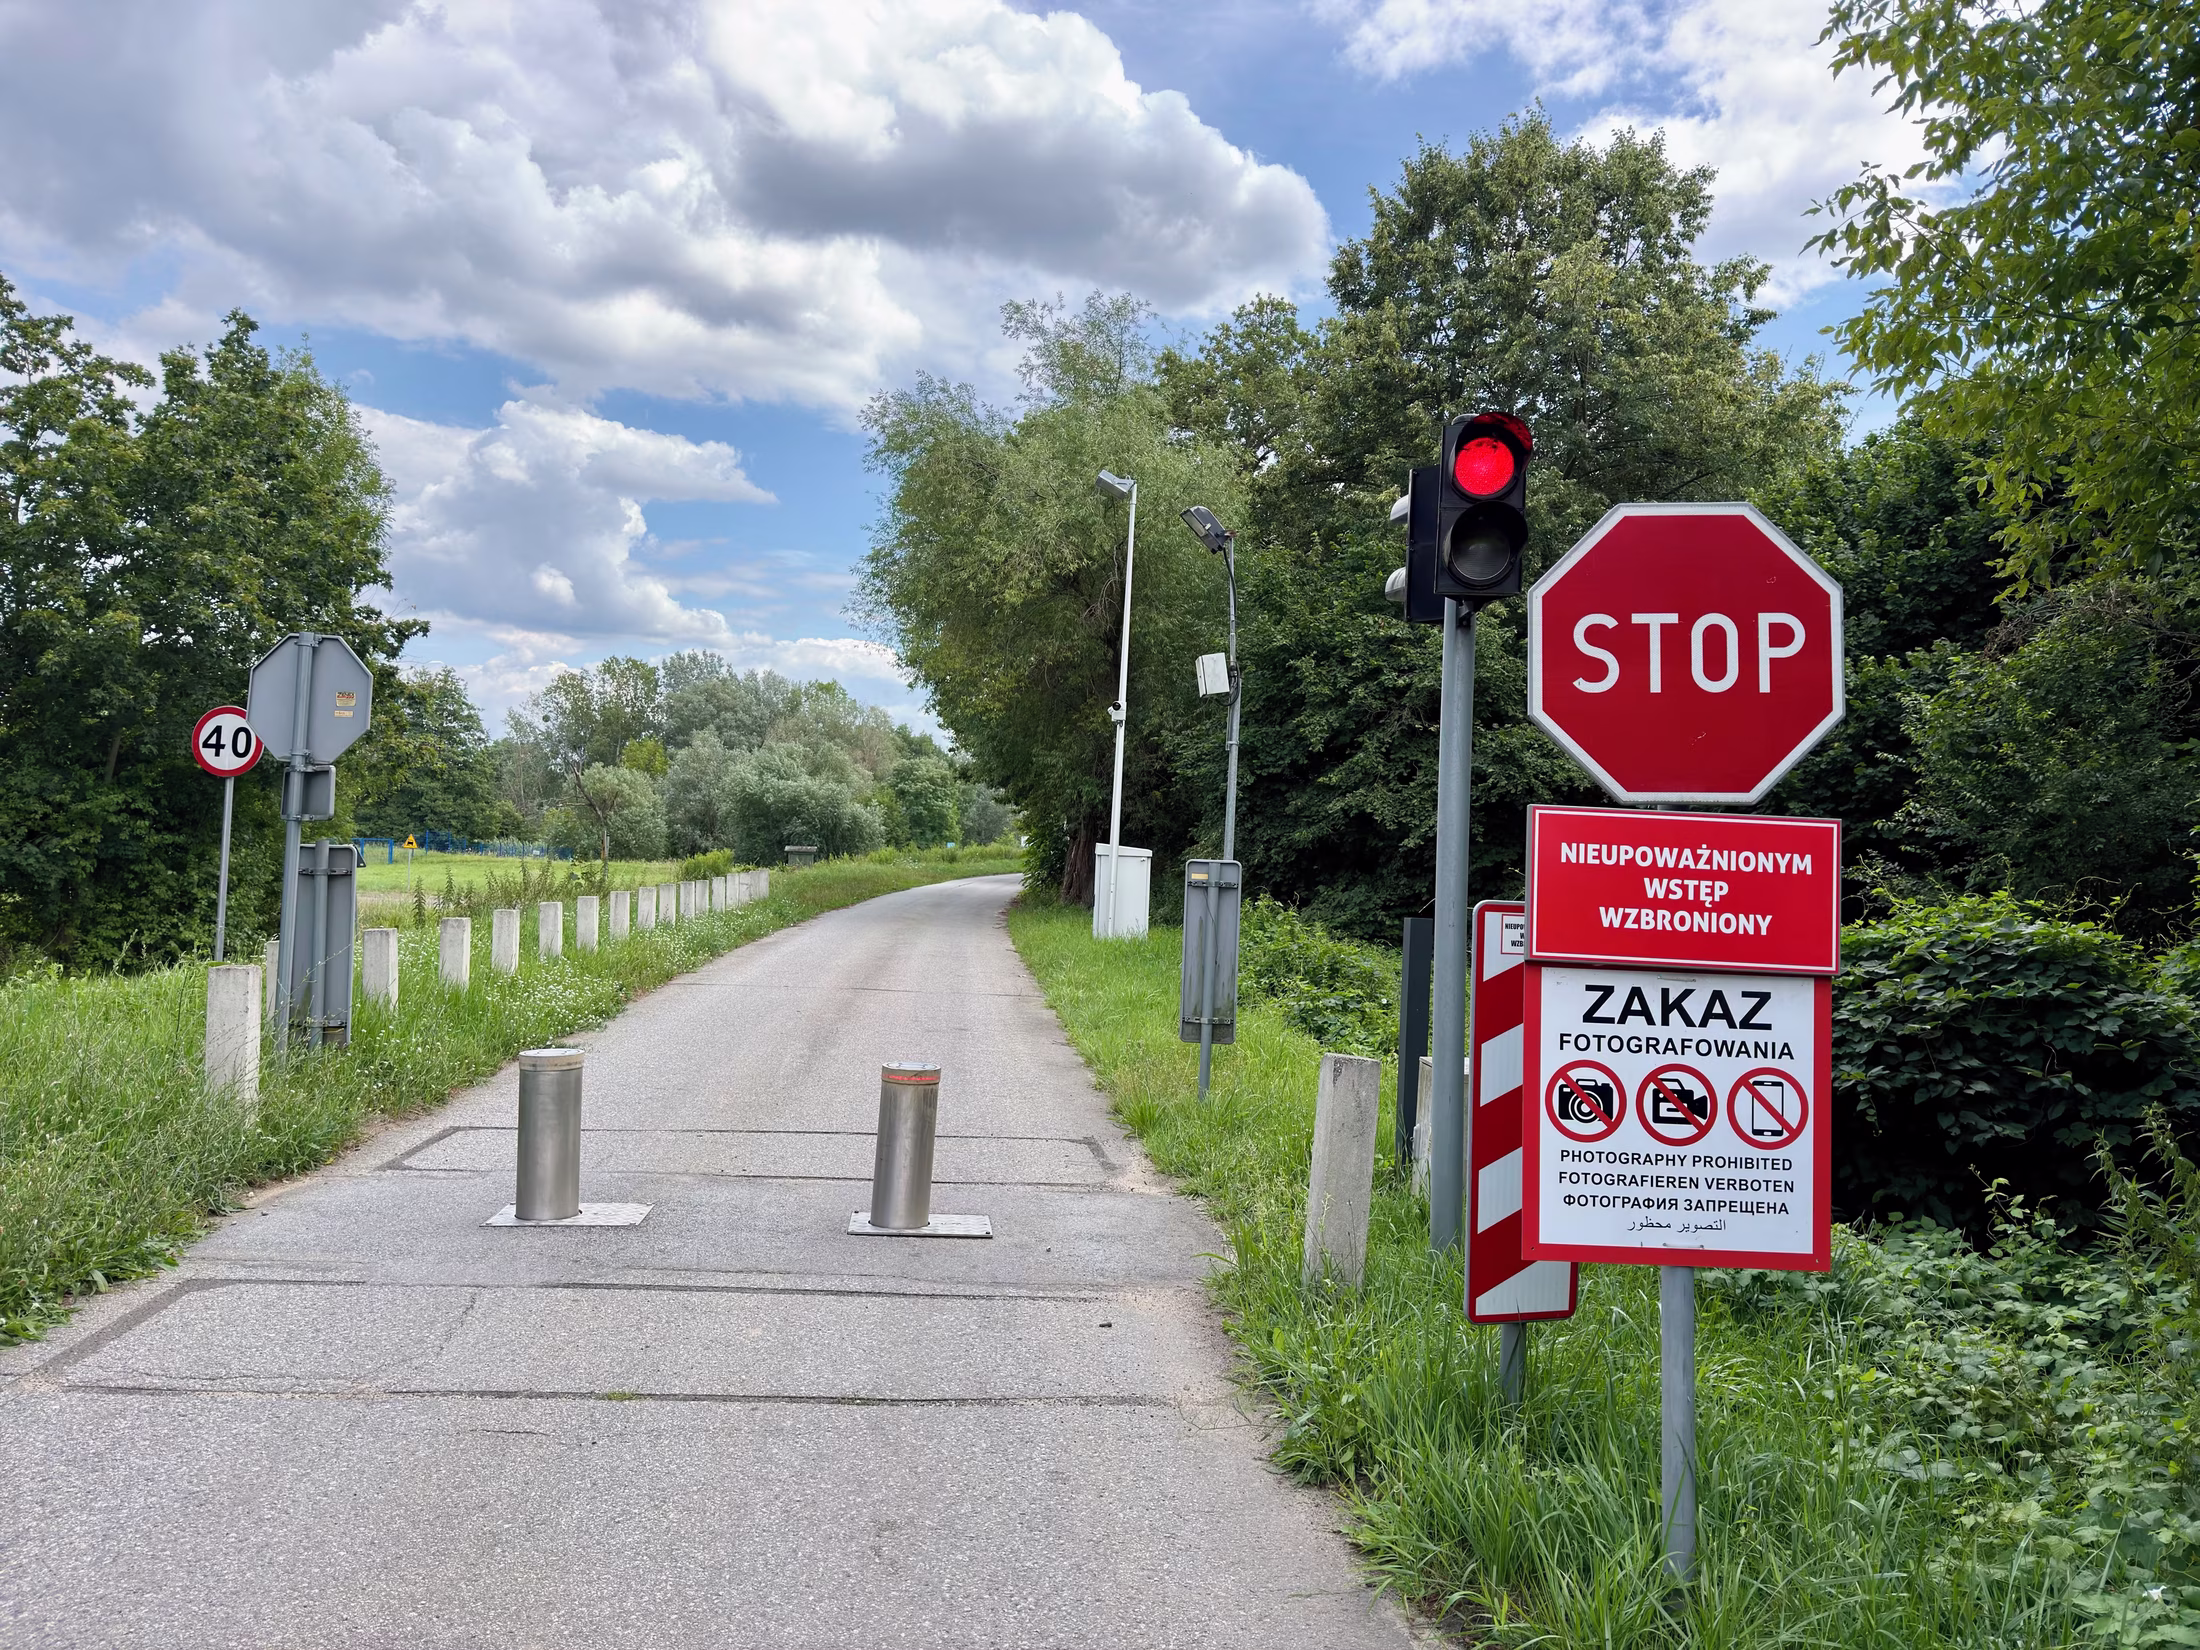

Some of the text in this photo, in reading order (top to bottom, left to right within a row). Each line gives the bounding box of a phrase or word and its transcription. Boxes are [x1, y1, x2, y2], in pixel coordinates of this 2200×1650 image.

[1572, 612, 1806, 693] STOP
[201, 725, 252, 758] 40
[1561, 842, 1812, 875] NIEUPOWAŻNIONYM
[1644, 877, 1729, 907] WSTĘP
[1599, 906, 1772, 936] WZBRONIONY
[1582, 984, 1772, 1030] ZAKAZ
[1559, 1033, 1794, 1060] FOTOGRAFOWANIA
[1560, 1150, 1792, 1171] PHOTOGRAPHY PROHIBITED
[1559, 1171, 1794, 1193] FOTOGRAFIEREN VERBOTEN
[1563, 1194, 1789, 1215] ФОТОГРАФИЯ ЗАПРЕЩЕНА
[1627, 1216, 1726, 1233] التصوير محظور
